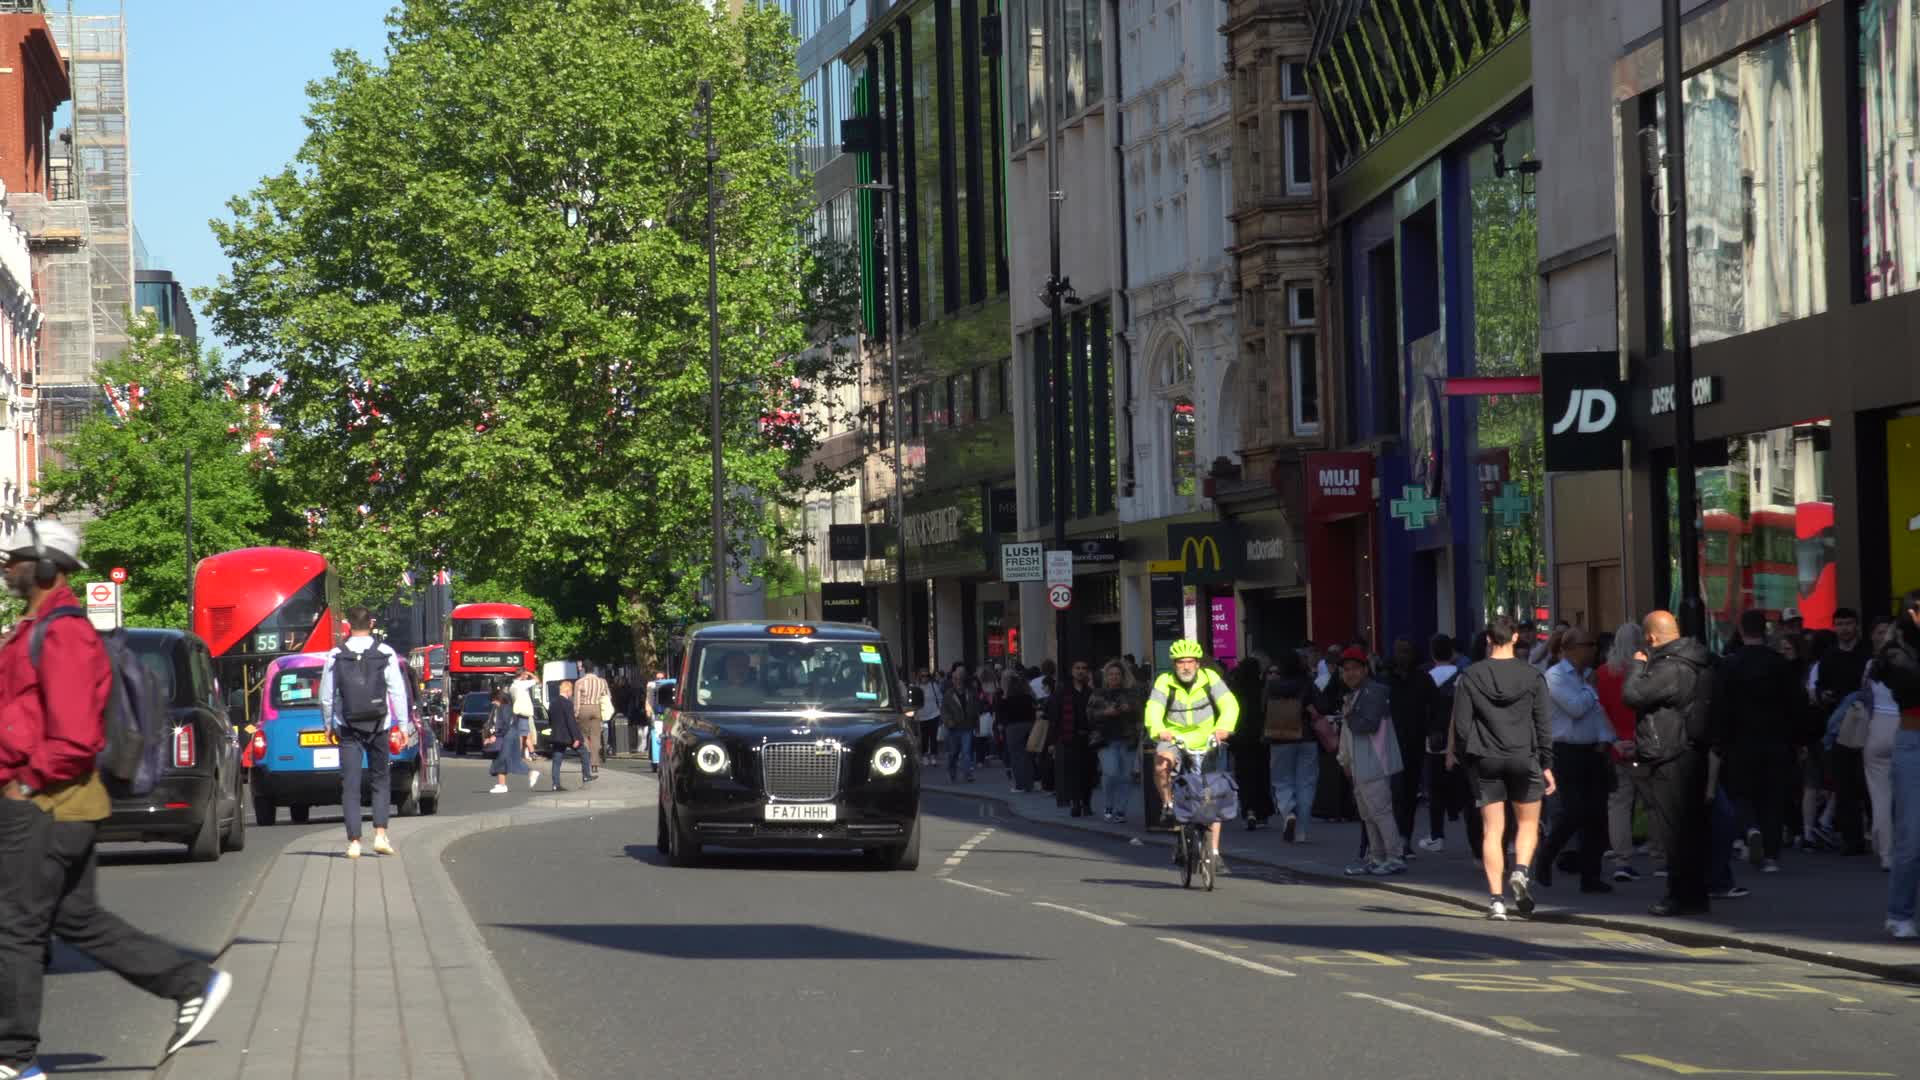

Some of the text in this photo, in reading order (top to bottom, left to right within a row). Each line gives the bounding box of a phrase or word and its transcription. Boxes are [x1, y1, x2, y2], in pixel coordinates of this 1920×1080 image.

[1552, 388, 1617, 435] JD
[1319, 468, 1360, 487] MUJI
[1005, 546, 1039, 557] LUSH
[1005, 557, 1040, 567] FRESH
[1052, 591, 1071, 603] 20
[1215, 623, 1228, 631] Yet
[257, 634, 277, 651] 55
[772, 806, 829, 818] FA71 HHH
[1413, 972, 1865, 1004] BUS
